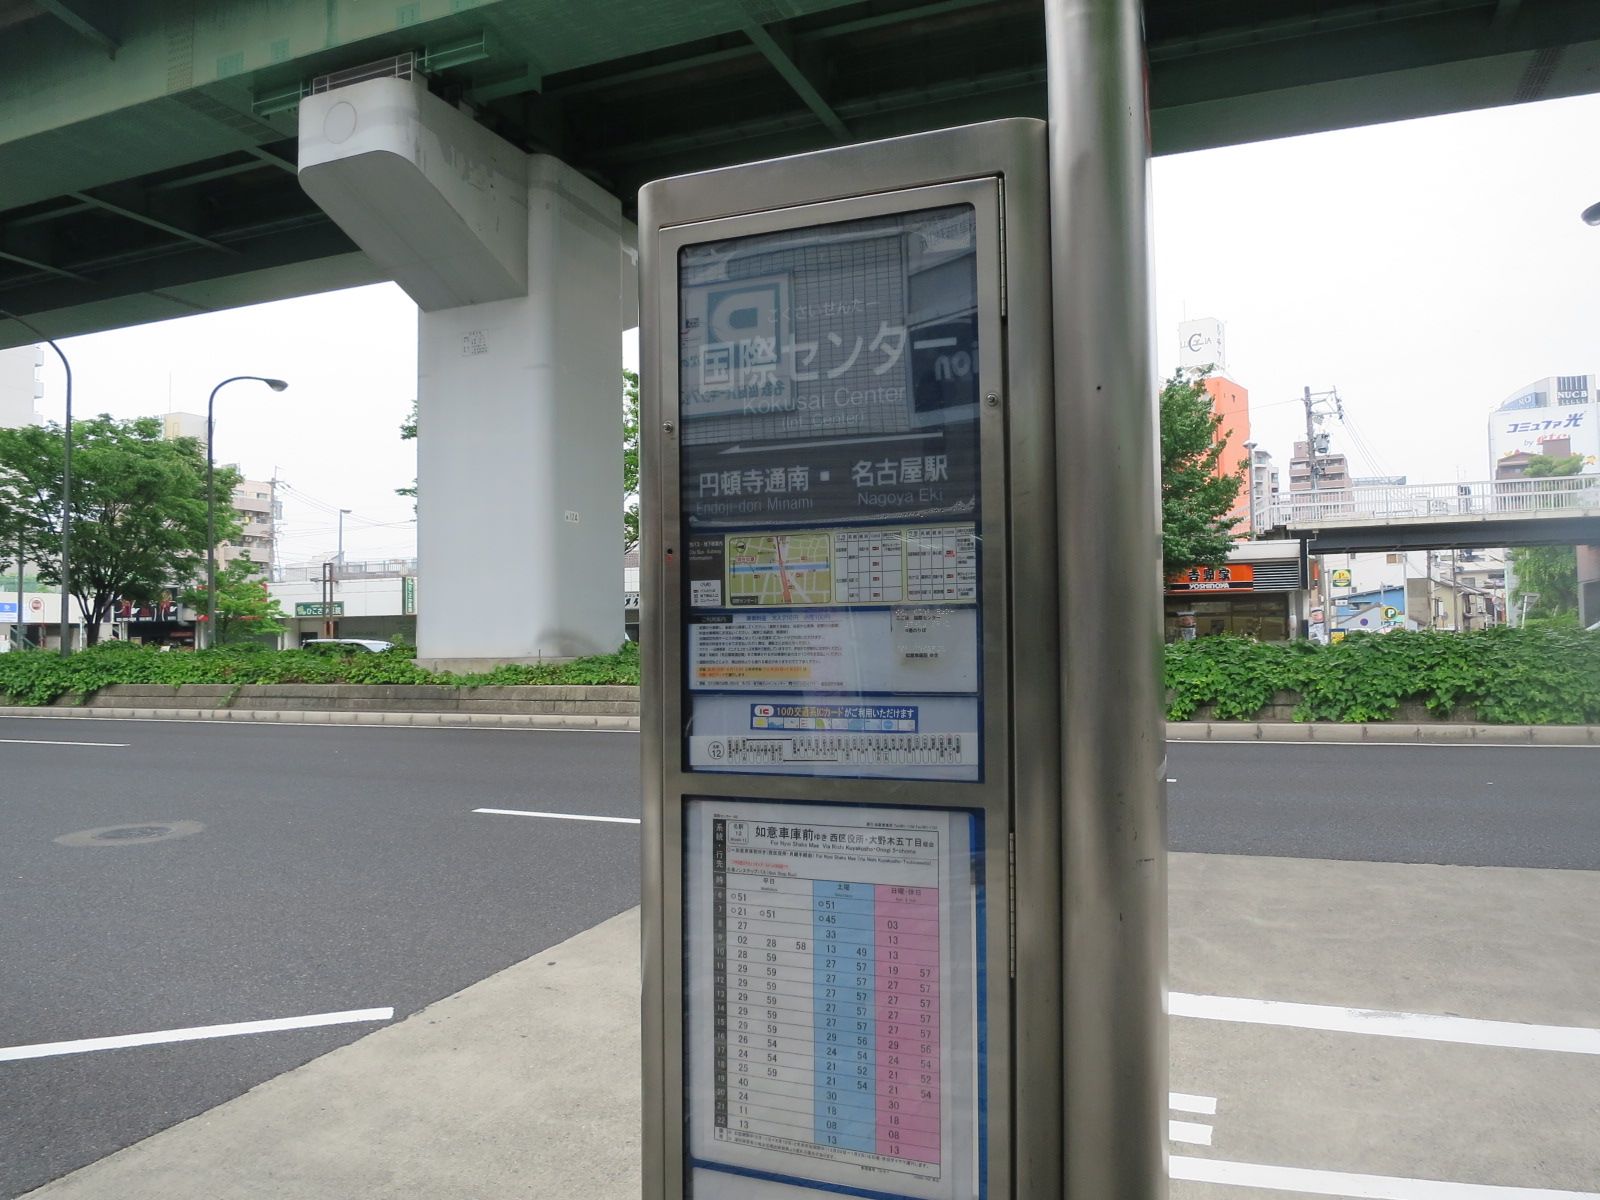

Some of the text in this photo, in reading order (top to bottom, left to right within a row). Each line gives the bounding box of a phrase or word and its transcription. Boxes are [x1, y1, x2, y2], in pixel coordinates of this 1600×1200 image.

[767, 299, 880, 324] こくさいせんたー
[699, 321, 957, 396] 国際センター
[743, 384, 905, 414] Kokusai Center
[1557, 390, 1588, 399] NUCB
[812, 412, 865, 428] Center)
[1506, 413, 1585, 434] コミュファ光
[699, 454, 948, 498] 円頓寺通南 名古屋駅
[767, 495, 813, 512] Minami
[858, 490, 914, 506] Nagoya
[919, 487, 943, 502] Eki
[712, 750, 721, 758] 12
[738, 893, 747, 901] 51
[826, 901, 836, 909] 51
[767, 910, 775, 918] 51
[826, 916, 836, 924] 45
[888, 920, 898, 930] 03
[738, 936, 747, 944] 02
[767, 939, 776, 947] 28
[796, 942, 806, 950] 58
[826, 945, 836, 953] 13
[857, 948, 866, 956] 49
[888, 951, 898, 960] 13
[826, 930, 836, 938] 33
[888, 936, 898, 944] 13
[738, 950, 747, 958] 28
[767, 953, 776, 961] 59
[826, 960, 836, 968] 27
[857, 963, 866, 971] 57
[888, 966, 898, 975] 19
[920, 969, 931, 977] 57
[738, 979, 747, 987] 29
[767, 982, 776, 990] 59
[826, 989, 836, 997] 27
[857, 992, 866, 1000] 57
[888, 996, 898, 1004] 27
[920, 1000, 931, 1008] 57
[767, 968, 776, 976] 59
[826, 975, 836, 983] 27
[857, 978, 866, 986] 57
[888, 981, 898, 989] 27
[920, 984, 931, 993] 57
[738, 993, 747, 1001] 29
[767, 996, 776, 1005] 59
[826, 1004, 836, 1012] 27
[857, 1007, 866, 1016] 57
[888, 1011, 898, 1020] 27
[920, 1015, 931, 1023] 57
[738, 1007, 747, 1015] 29
[767, 1011, 776, 1019] 59
[826, 1018, 836, 1027] 27
[857, 1022, 866, 1030] 57
[888, 1026, 899, 1035] 27
[921, 1030, 931, 1039] 57
[738, 1021, 748, 1029] 29
[767, 1025, 777, 1033] 59
[827, 1033, 837, 1041] 29
[857, 1037, 867, 1046] 56
[888, 1041, 899, 1049] 29
[921, 1045, 931, 1054] 56
[738, 1035, 748, 1044] 26
[767, 1039, 777, 1047] 54
[827, 1048, 837, 1056] 24
[857, 1052, 867, 1060] 54
[888, 1056, 899, 1065] 24
[921, 1060, 931, 1069] 54
[738, 1050, 748, 1058] 24
[767, 1054, 777, 1062] 54
[827, 1062, 837, 1071] 21
[857, 1067, 867, 1076] 52
[888, 1071, 899, 1080] 21
[921, 1075, 931, 1084] 52
[738, 1064, 748, 1072] 25
[767, 1068, 777, 1076] 59
[827, 1077, 837, 1085] 21
[857, 1082, 867, 1090] 54
[888, 1086, 899, 1095] 21
[921, 1090, 931, 1099] 54
[738, 1078, 748, 1086] 40
[827, 1091, 837, 1100] 30
[888, 1101, 899, 1109] 30
[738, 1092, 748, 1100] 24
[827, 1106, 837, 1115] 18
[888, 1116, 899, 1125] 18
[738, 1106, 748, 1114] 11
[827, 1121, 837, 1130] 08
[888, 1131, 899, 1139] 08
[738, 1120, 748, 1129] 13
[827, 1136, 837, 1144] 13
[888, 1145, 899, 1154] 13
